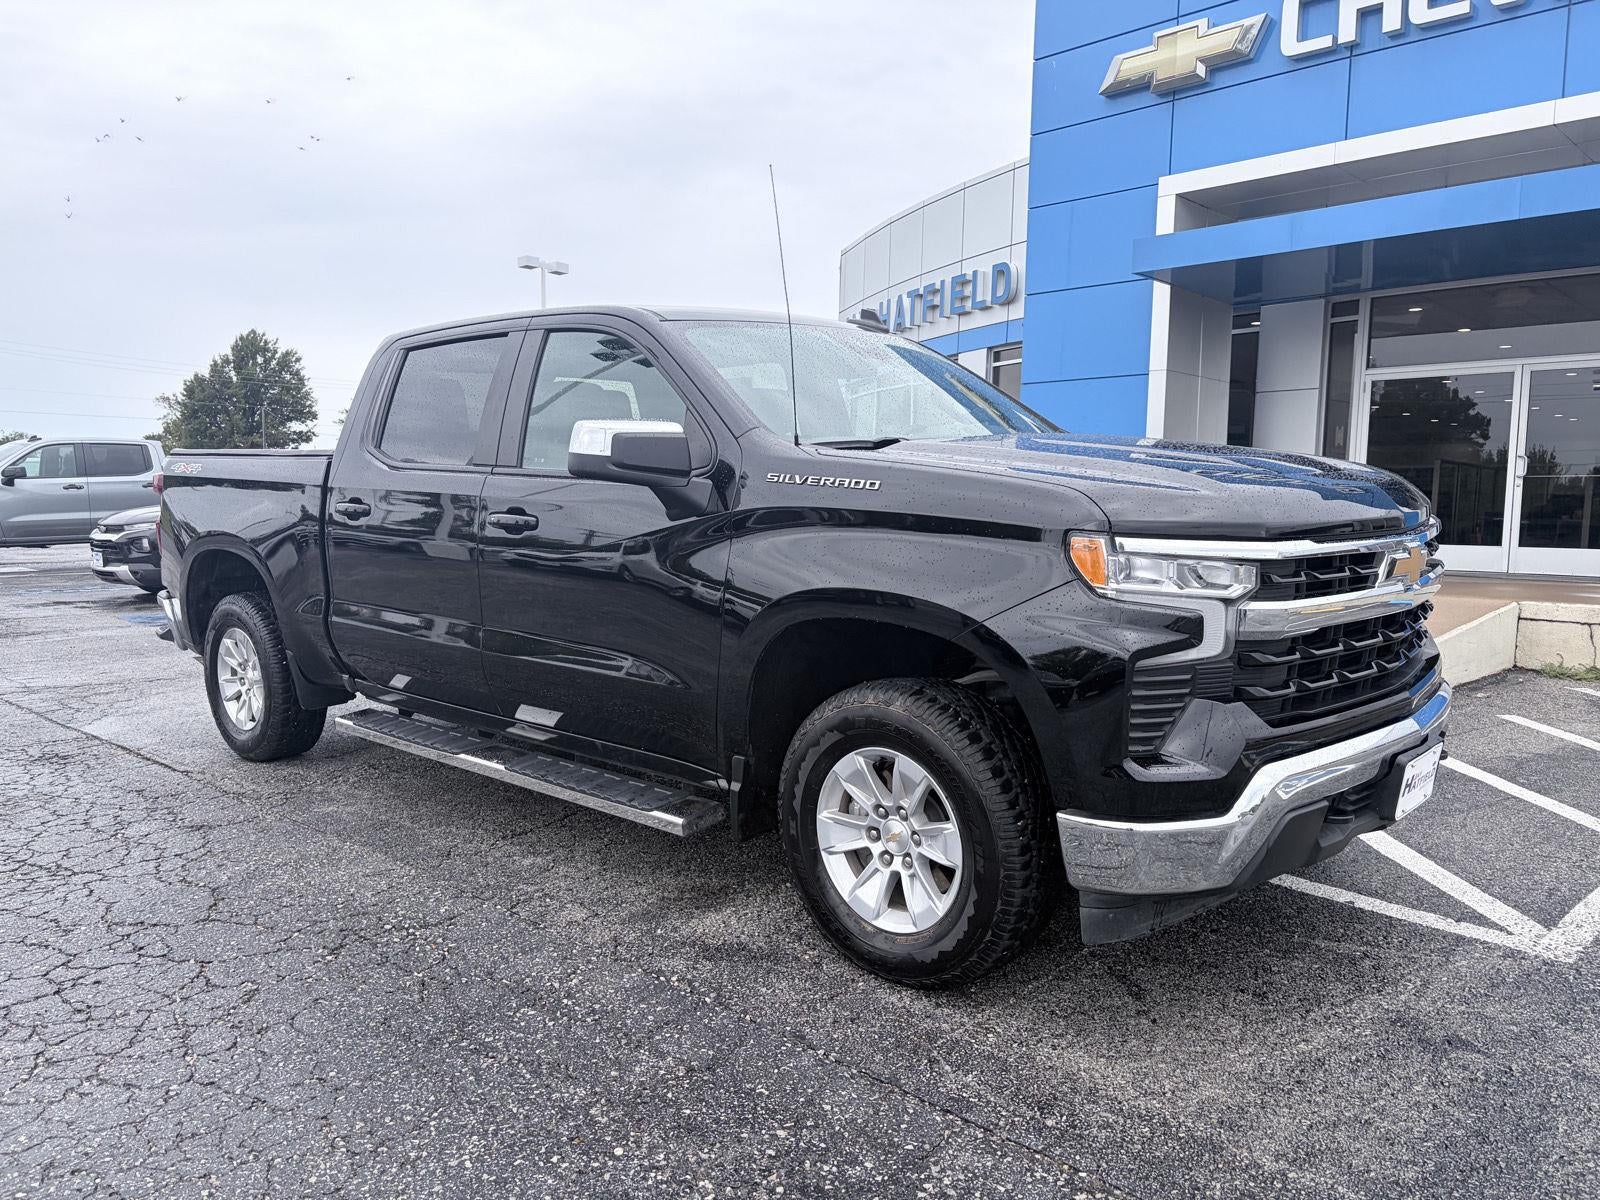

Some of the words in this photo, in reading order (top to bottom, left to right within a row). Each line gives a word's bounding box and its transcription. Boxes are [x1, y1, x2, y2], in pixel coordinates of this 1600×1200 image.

[1280, 0, 1525, 57] CH
[879, 262, 1018, 334] HATFIELD
[765, 472, 881, 491] SILVERADO
